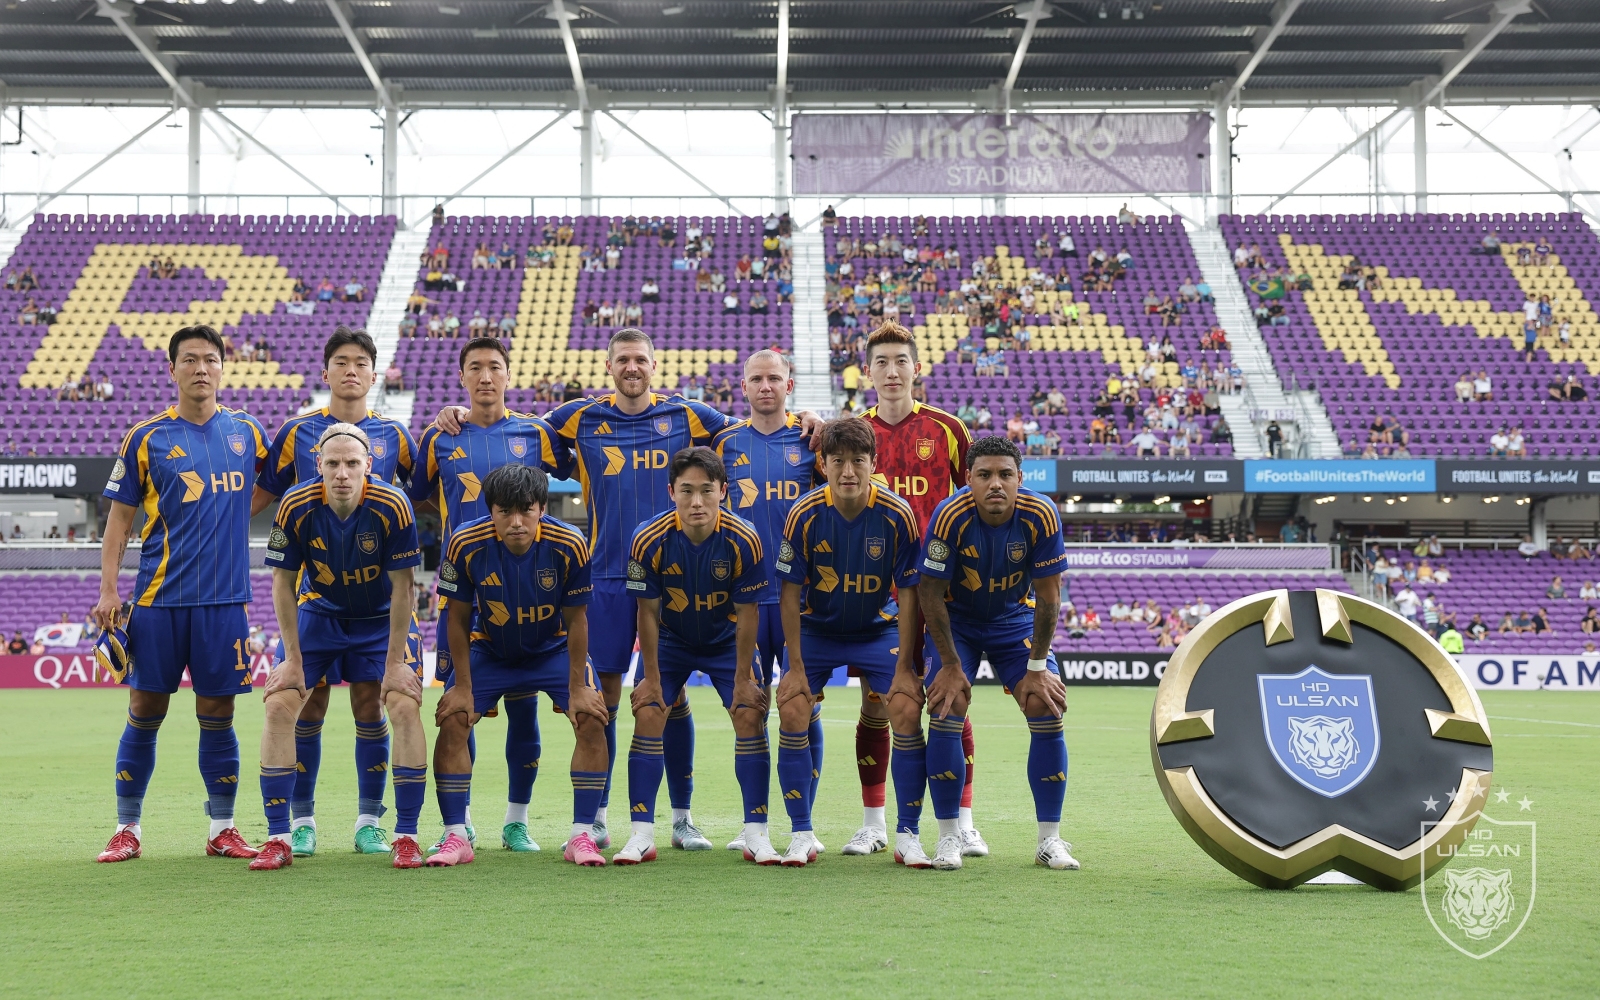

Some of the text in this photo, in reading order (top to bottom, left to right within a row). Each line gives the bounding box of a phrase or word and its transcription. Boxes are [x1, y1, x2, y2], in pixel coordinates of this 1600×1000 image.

[947, 166, 1052, 186] STADIUM
[632, 449, 669, 470] HD
[0, 464, 77, 488] FIFACWC
[210, 471, 245, 493] HD
[893, 475, 929, 496] HD
[1072, 469, 1196, 484] FOOTBALL UNITES the World
[1254, 469, 1426, 483] #FootballUnitesTheWorld
[1452, 470, 1498, 483] FOOTBALL
[1498, 470, 1532, 483] UNITES
[1532, 469, 1550, 483] the
[1549, 469, 1579, 484] World
[765, 480, 800, 501] HD
[1068, 552, 1189, 566] nter&co STADIUM
[342, 564, 381, 586] HD
[843, 573, 881, 593] HD
[989, 570, 1024, 593] HD
[694, 590, 729, 612] HD
[517, 604, 555, 625] HD
[1062, 660, 1150, 680] WORLD
[1477, 660, 1529, 685] OF
[1301, 682, 1330, 692] HD
[1276, 695, 1359, 707] ULSAN
